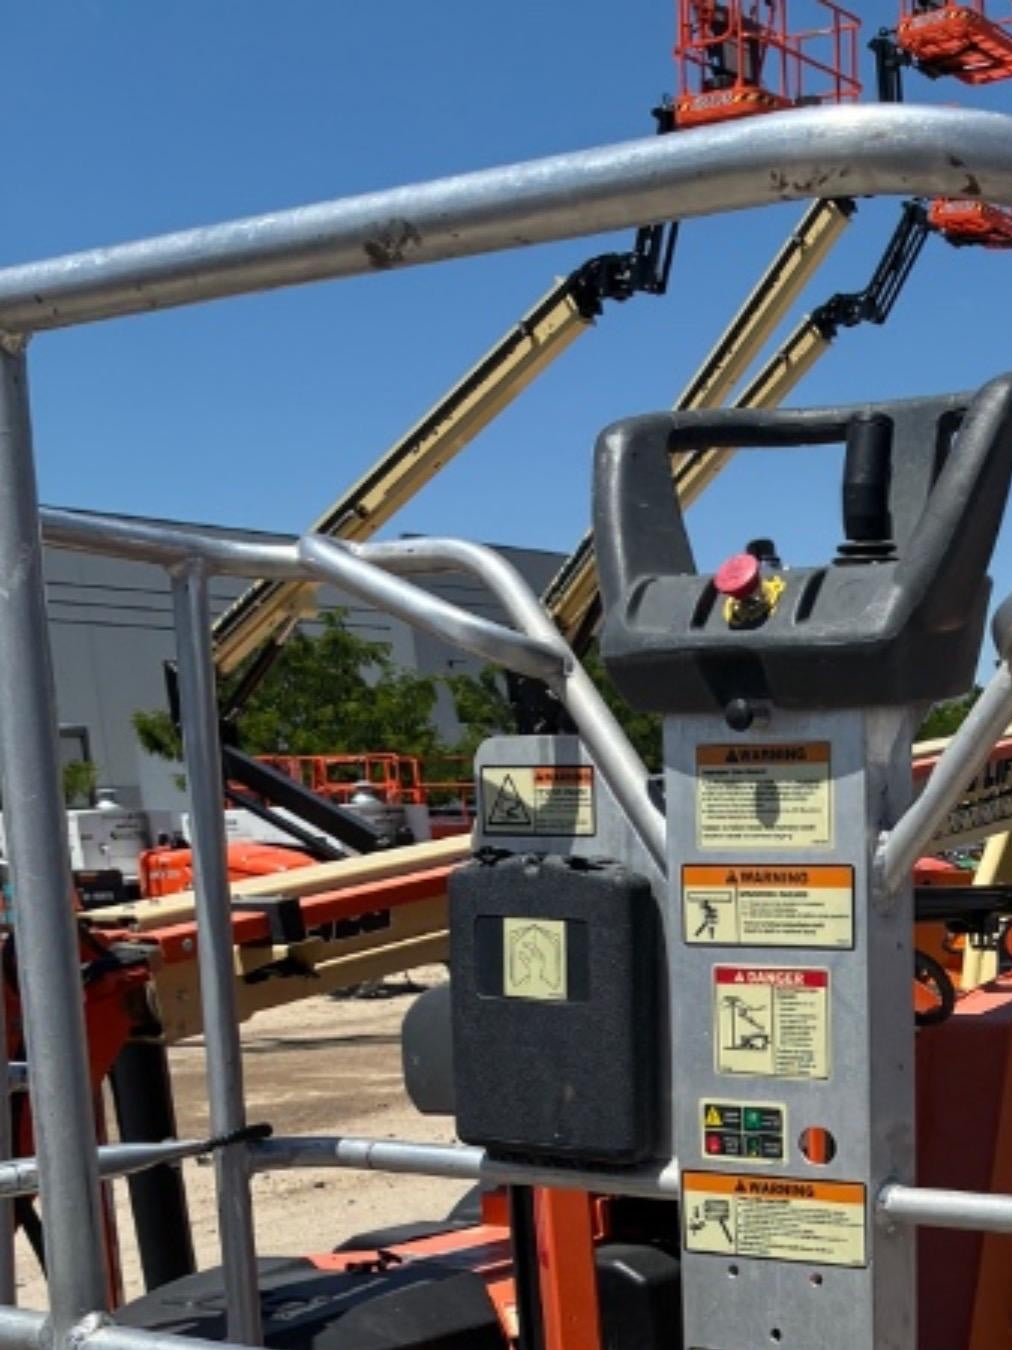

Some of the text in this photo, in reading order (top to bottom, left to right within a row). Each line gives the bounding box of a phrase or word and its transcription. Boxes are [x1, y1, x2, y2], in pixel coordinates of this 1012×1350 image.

[740, 871, 808, 885] WARNING
[747, 972, 805, 986] DANGER
[749, 1182, 815, 1198] WARNING
